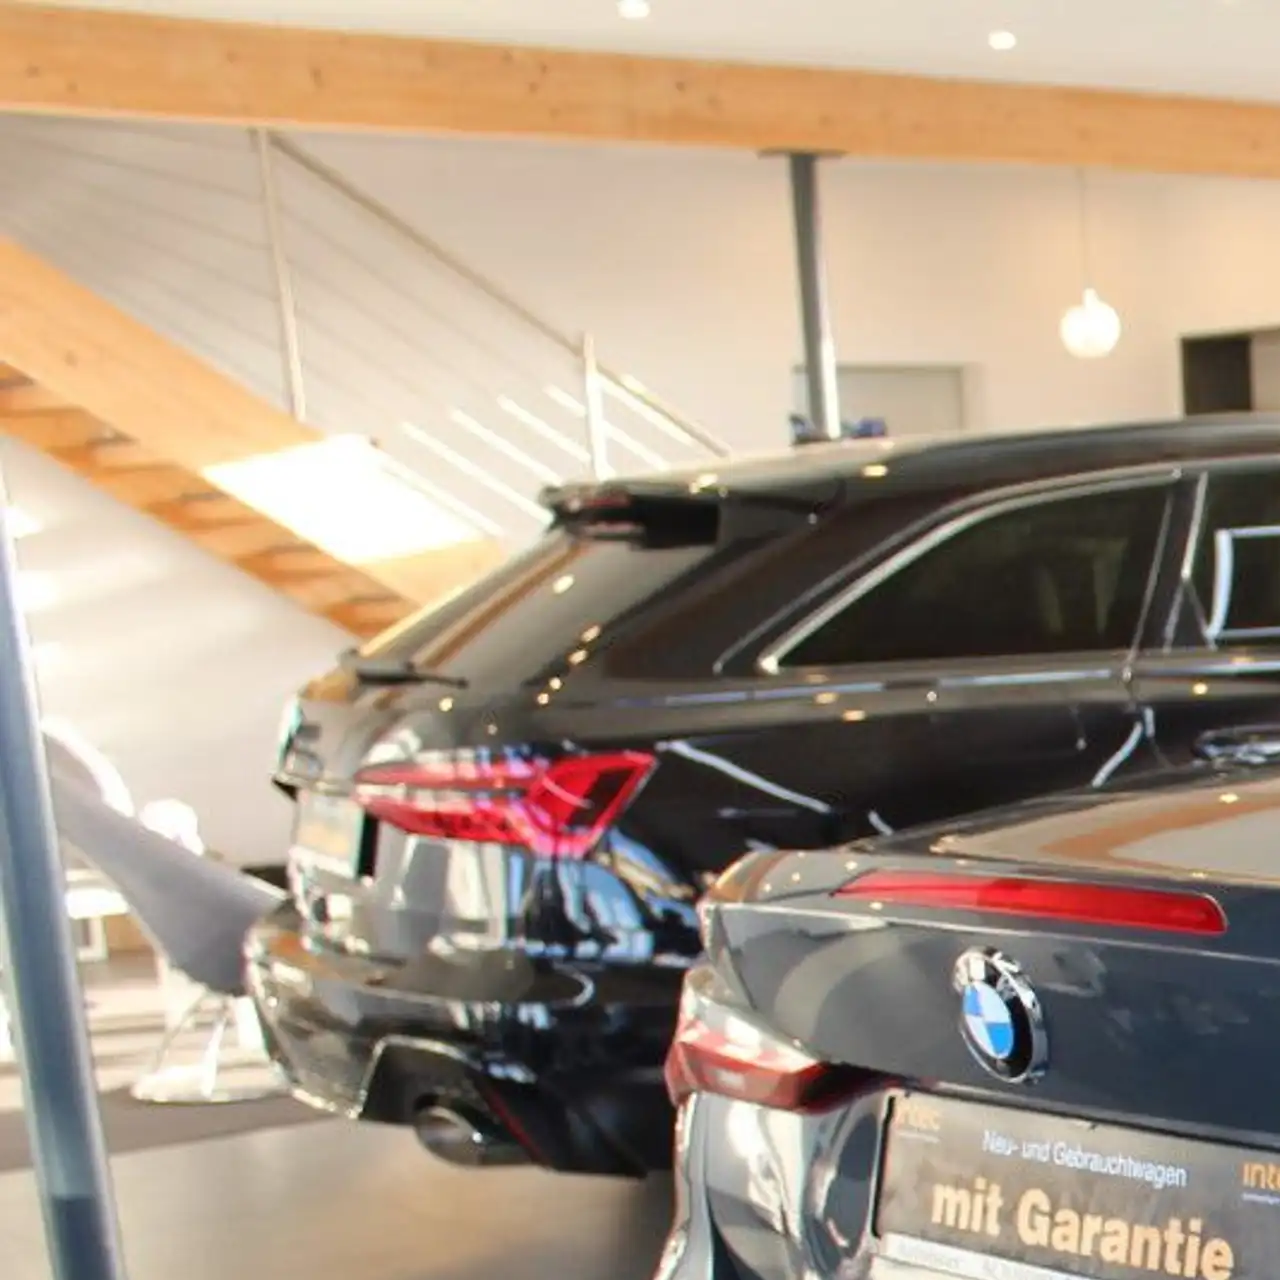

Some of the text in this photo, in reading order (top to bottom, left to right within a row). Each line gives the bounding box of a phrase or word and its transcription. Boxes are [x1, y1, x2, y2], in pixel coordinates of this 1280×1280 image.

[982, 1129, 1187, 1189] Neu- und Gebrauchtwagen
[931, 1177, 1004, 1236] mit
